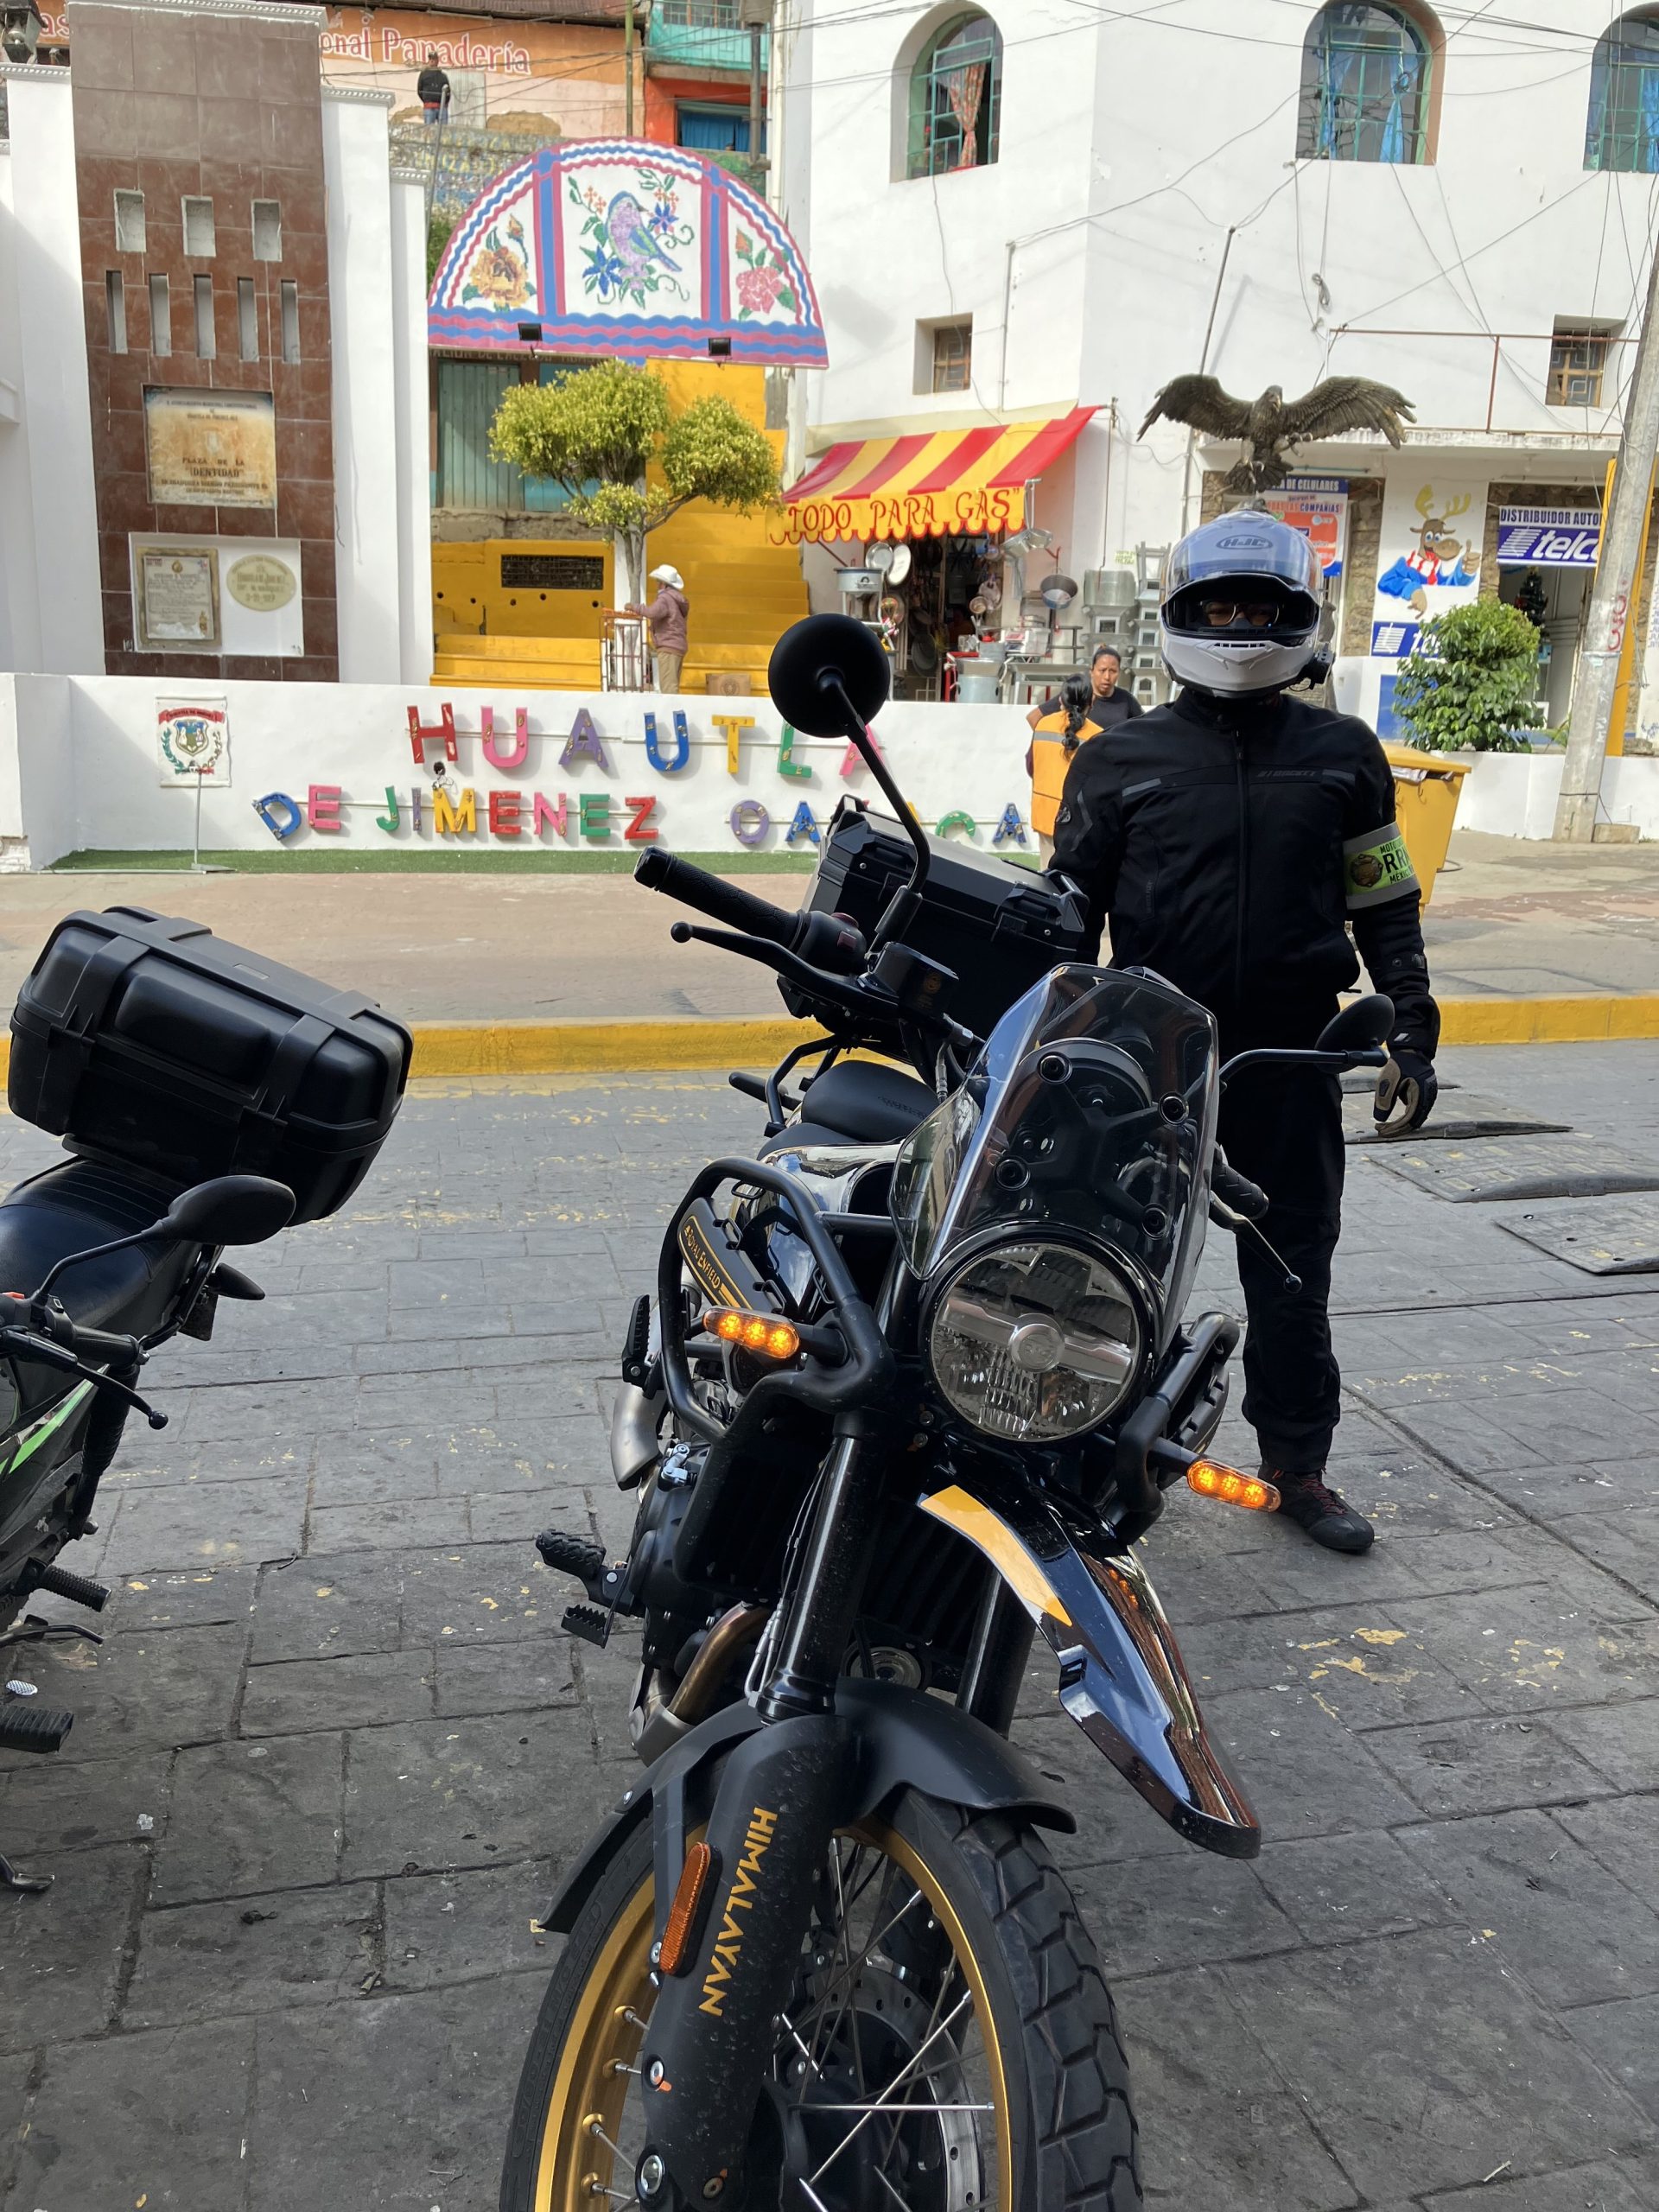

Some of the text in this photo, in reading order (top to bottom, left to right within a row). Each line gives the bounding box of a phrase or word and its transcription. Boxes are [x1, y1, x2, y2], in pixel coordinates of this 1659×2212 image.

[382, 27, 532, 76] Panadería
[1297, 478, 1340, 492] CELULARES
[788, 503, 852, 533] TODO
[869, 495, 937, 531] PARA
[1500, 508, 1599, 526] DISTRIBUIDOR AUTO
[1224, 537, 1268, 547] HJC
[251, 784, 342, 841] DE
[375, 785, 659, 840] JIMENEZ
[683, 1224, 721, 1289] ROYAL ENFIELD
[698, 1807, 778, 2017] HIMALAYAN
